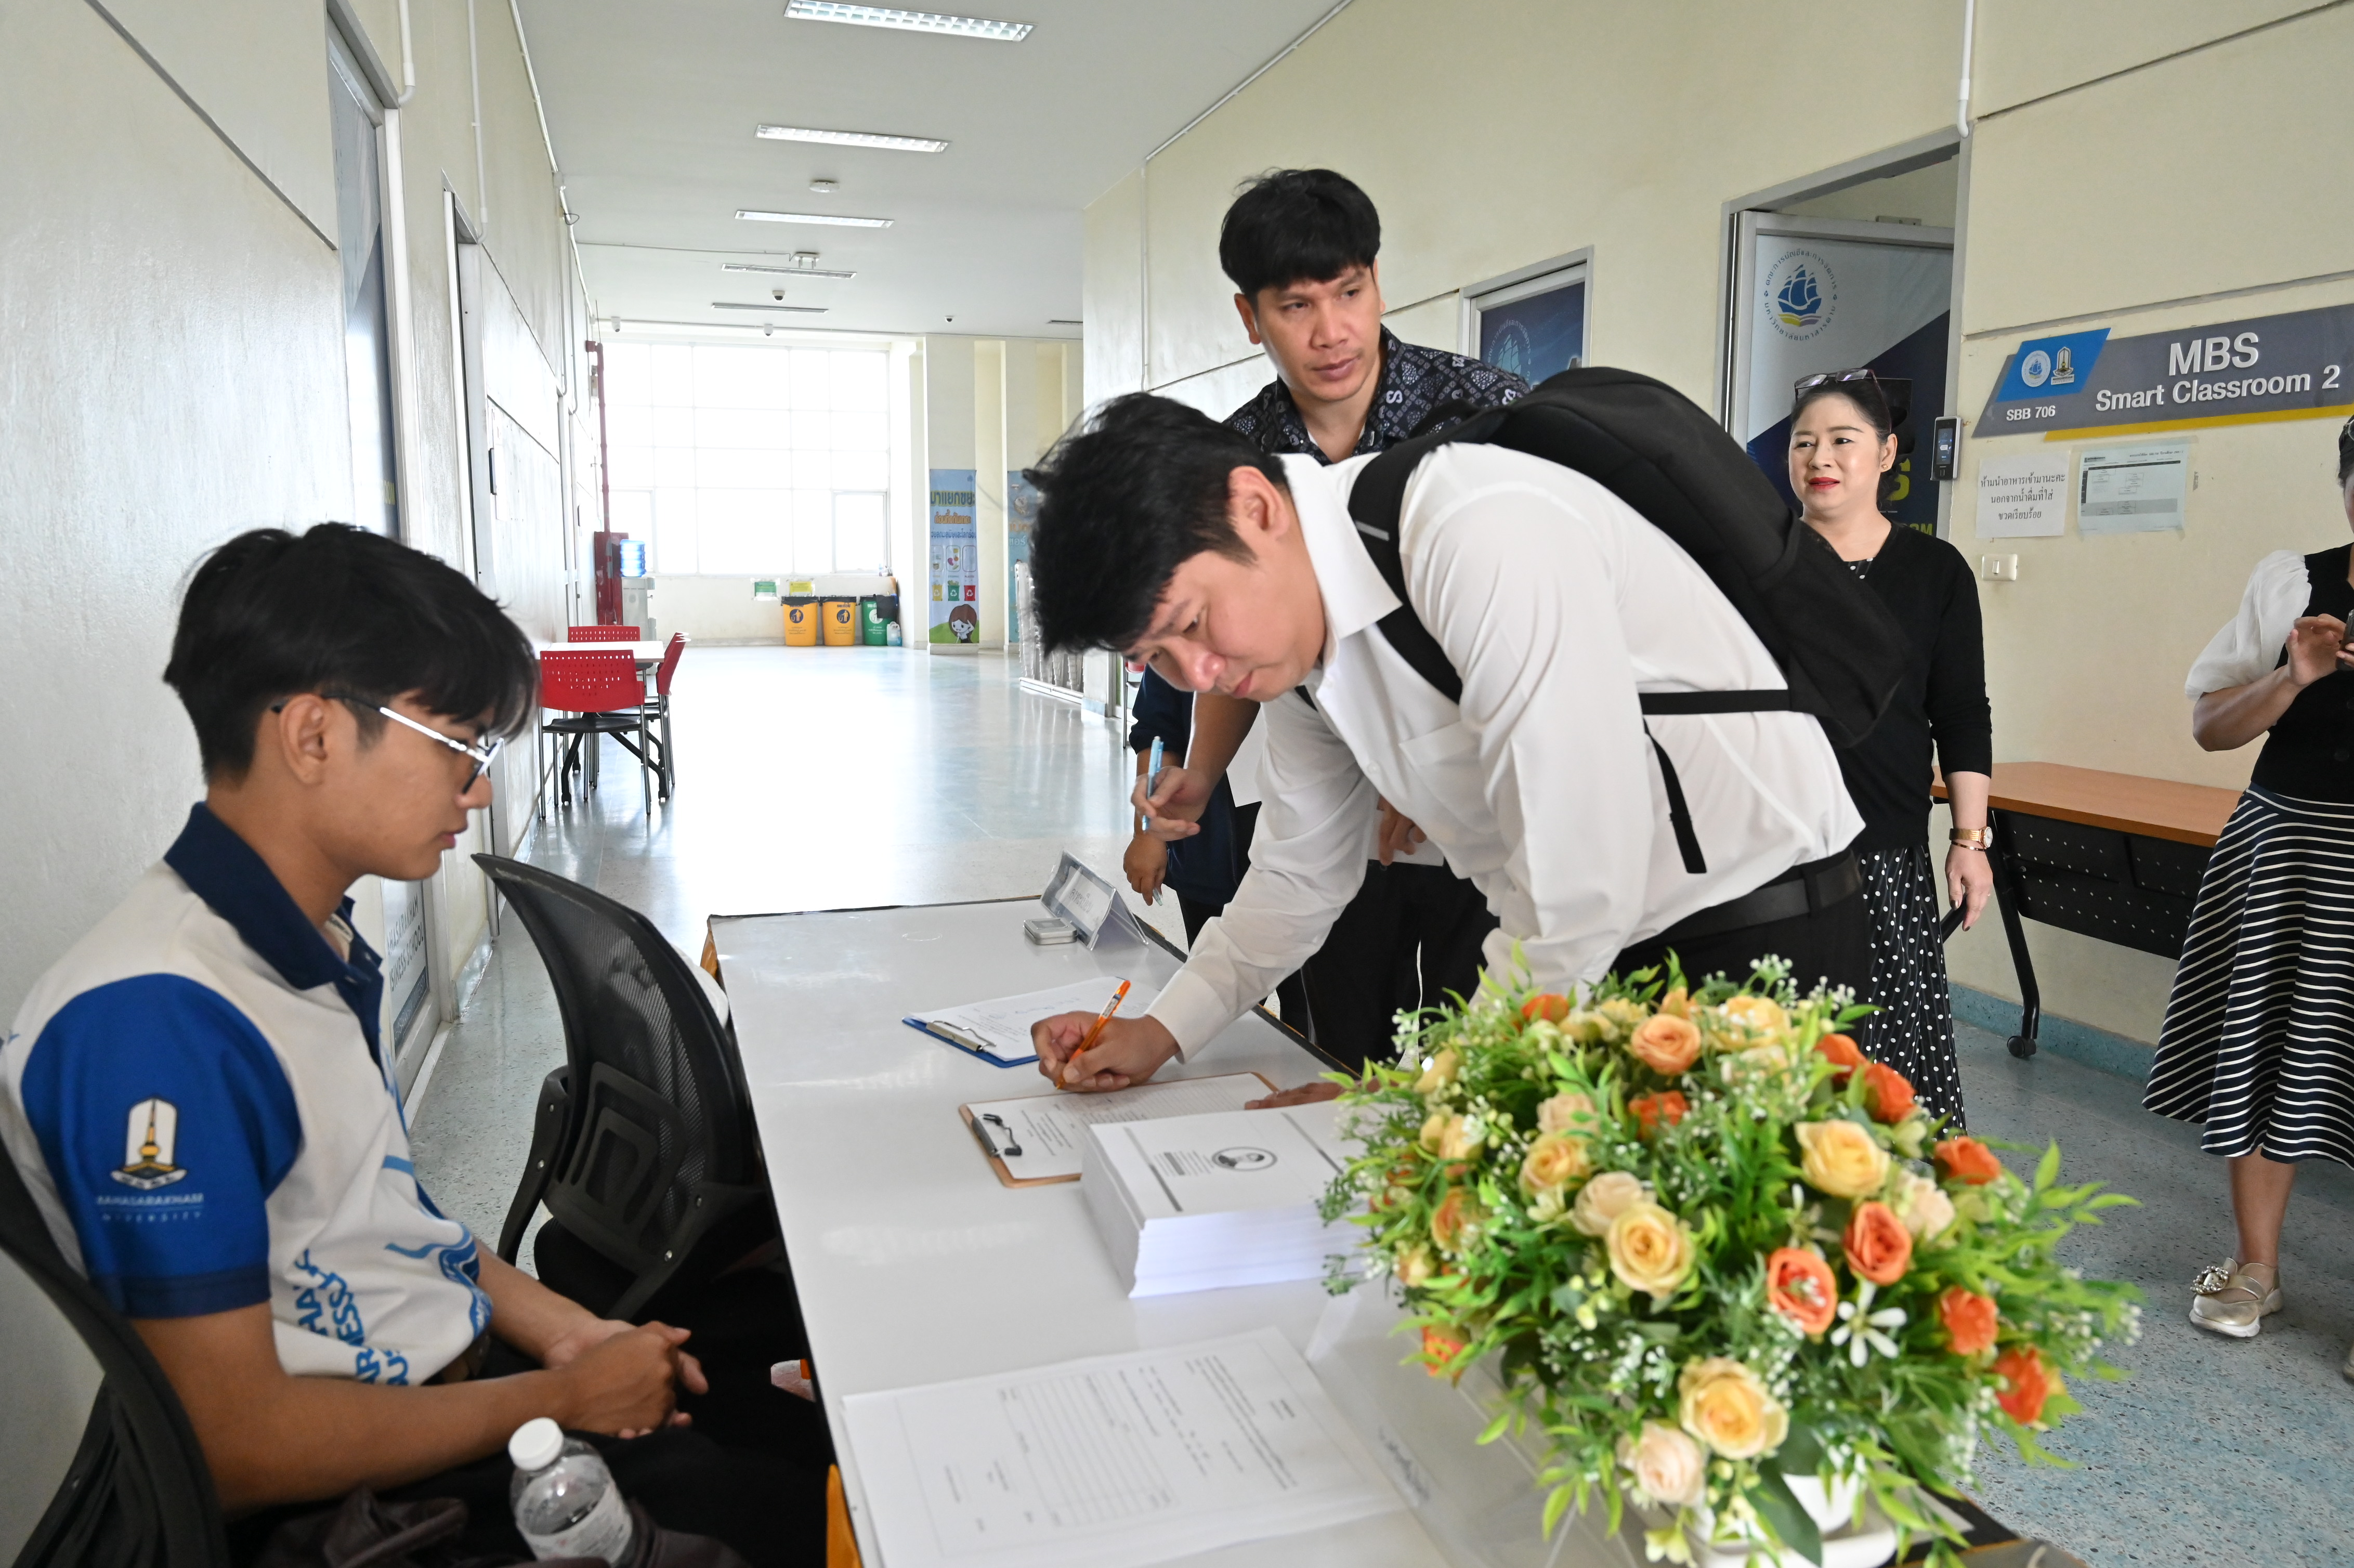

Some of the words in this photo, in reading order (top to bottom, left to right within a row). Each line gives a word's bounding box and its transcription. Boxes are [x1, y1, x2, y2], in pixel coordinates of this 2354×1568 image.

[2168, 332, 2259, 376] MBS
[2096, 384, 2164, 411] Smart
[2172, 373, 2310, 404] Classroom
[2321, 364, 2340, 389] 2
[2006, 408, 2031, 421] SBB
[2035, 405, 2056, 419] 706
[1991, 486, 2054, 504] นอกจากน้ำดื่มที่ใส่
[1998, 506, 2042, 520] ขวดเรียบร้อย
[407, 921, 425, 966] SCHOOL
